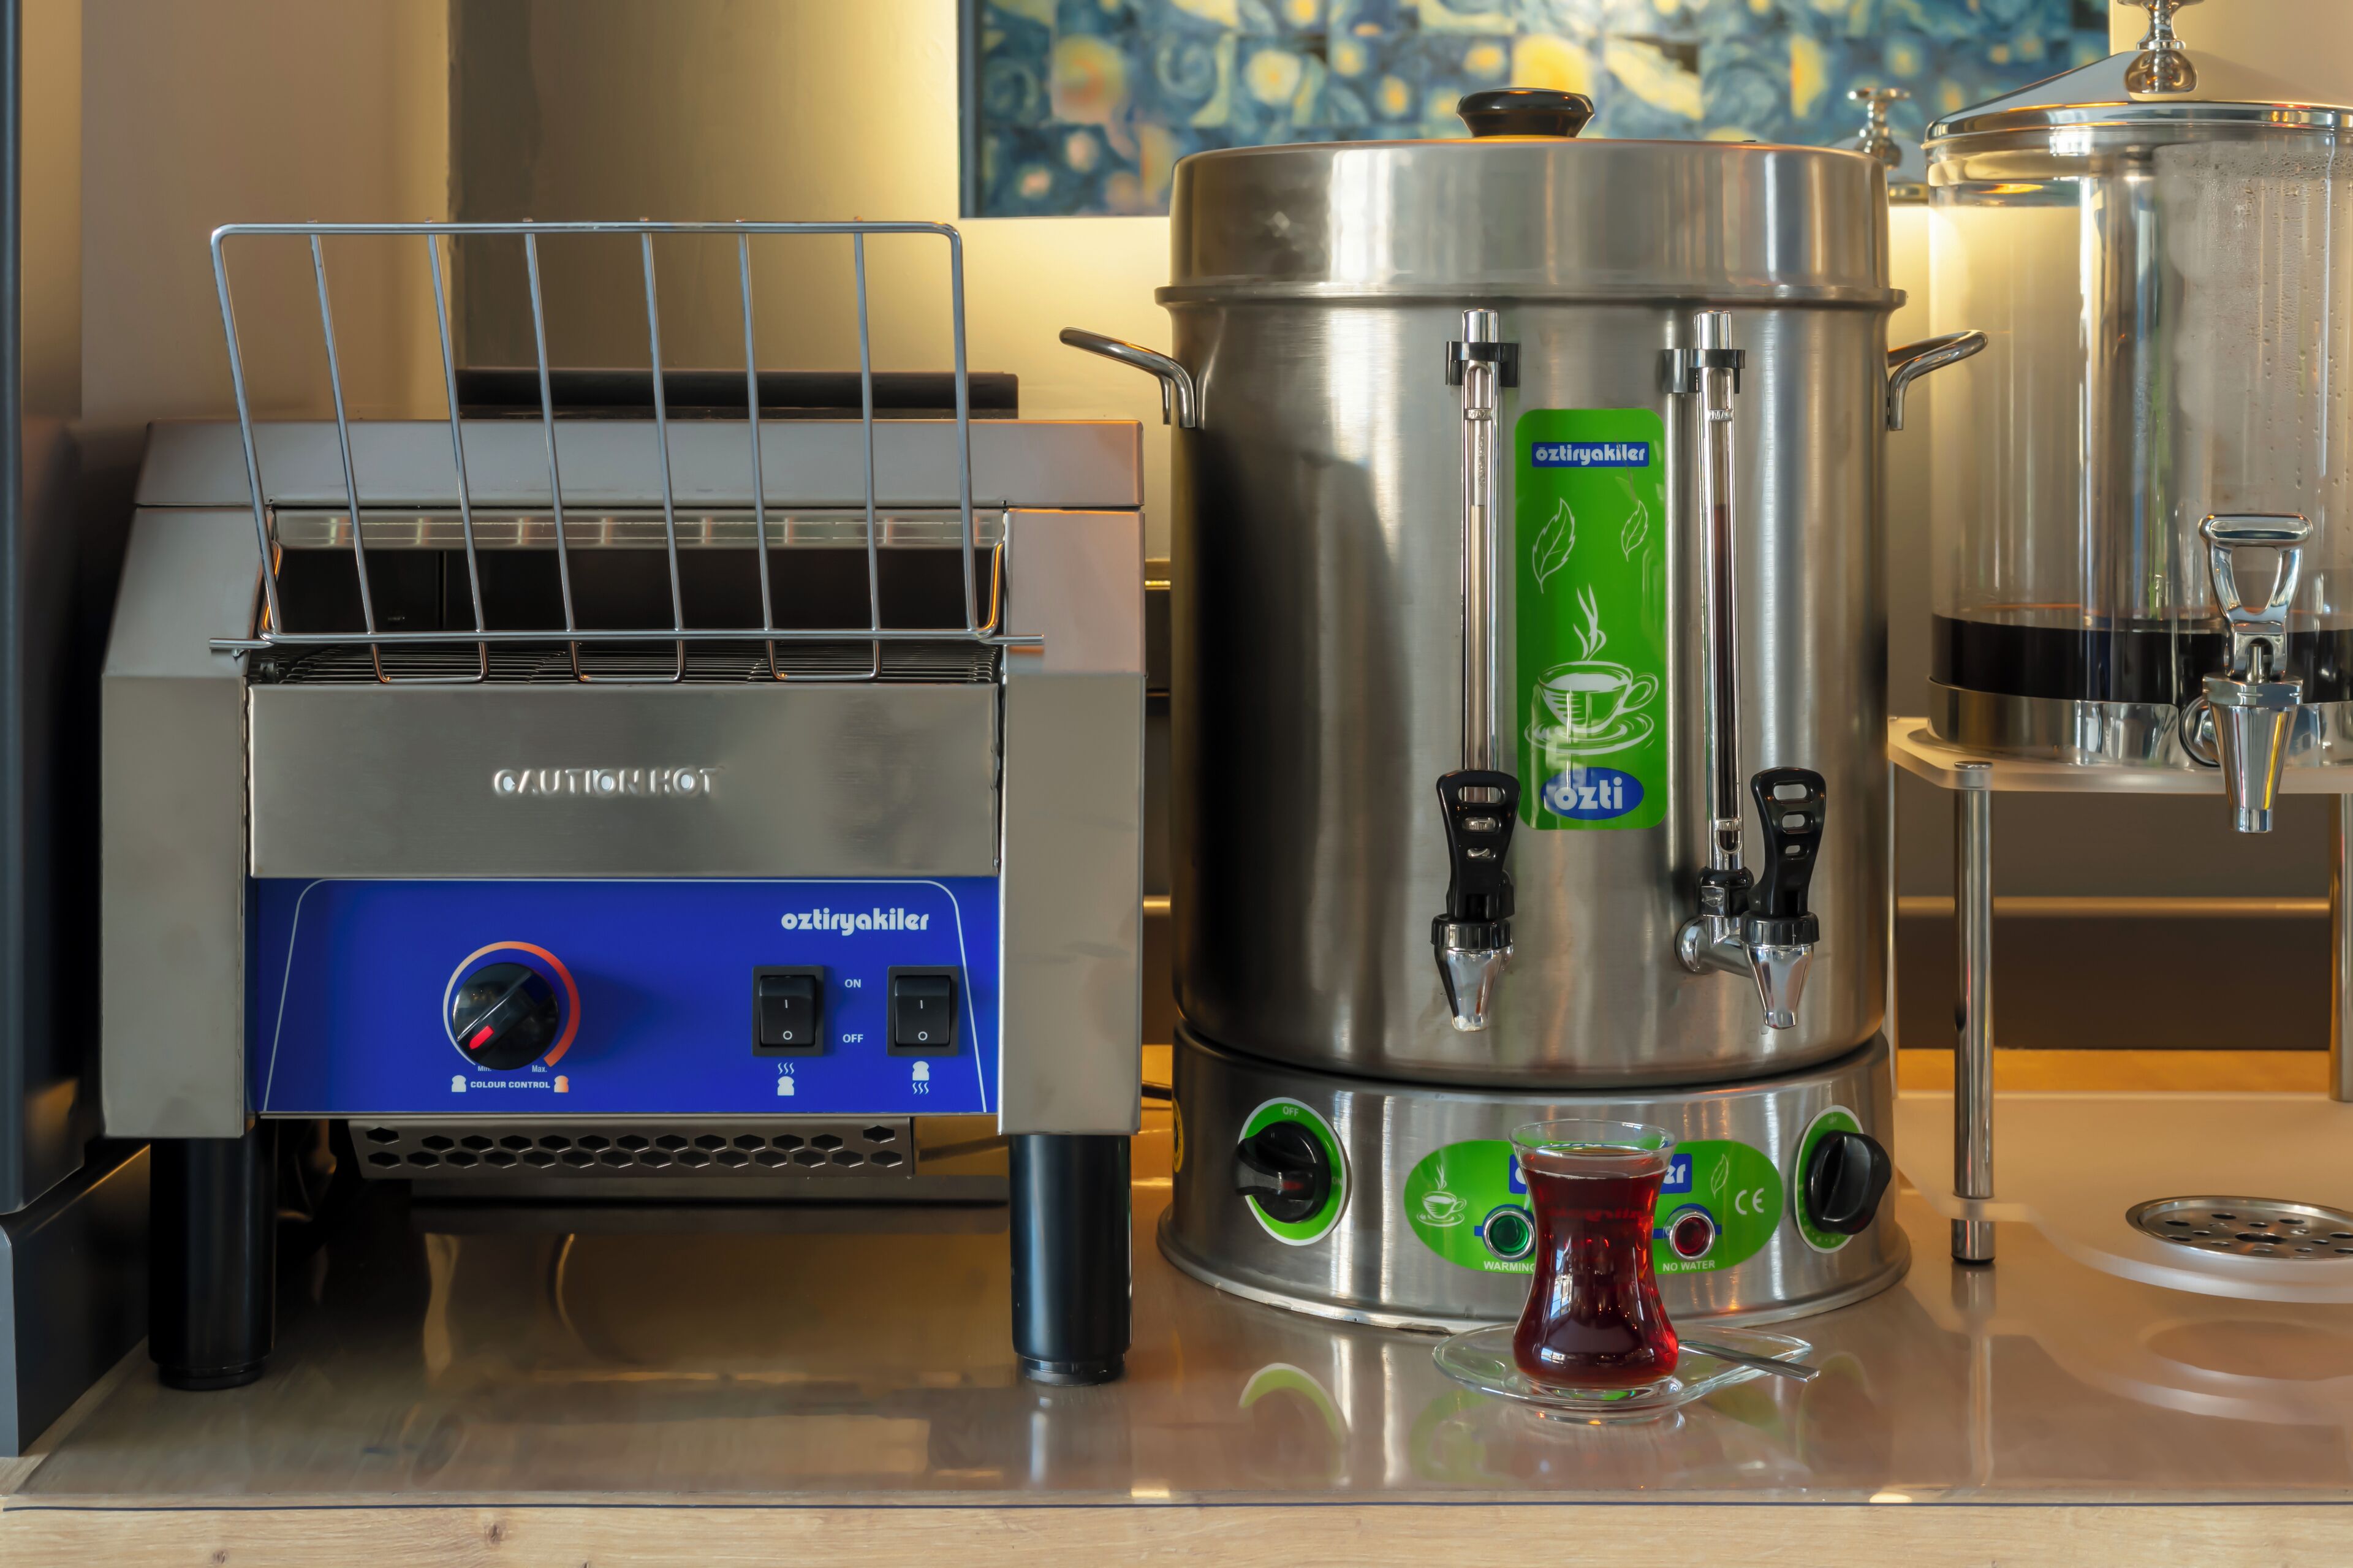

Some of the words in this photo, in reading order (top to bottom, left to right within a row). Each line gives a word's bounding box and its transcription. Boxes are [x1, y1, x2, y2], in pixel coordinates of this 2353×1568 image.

[493, 768, 640, 795] CAUTION
[650, 767, 718, 795] HOT
[781, 907, 929, 936] oztiryakiler
[844, 979, 862, 988] ON
[1283, 1106, 1299, 1116] OFF
[1332, 1176, 1343, 1186] ON
[1735, 1188, 1764, 1214] CE
[1663, 1263, 1678, 1271] NO
[1681, 1260, 1715, 1270] WATER
